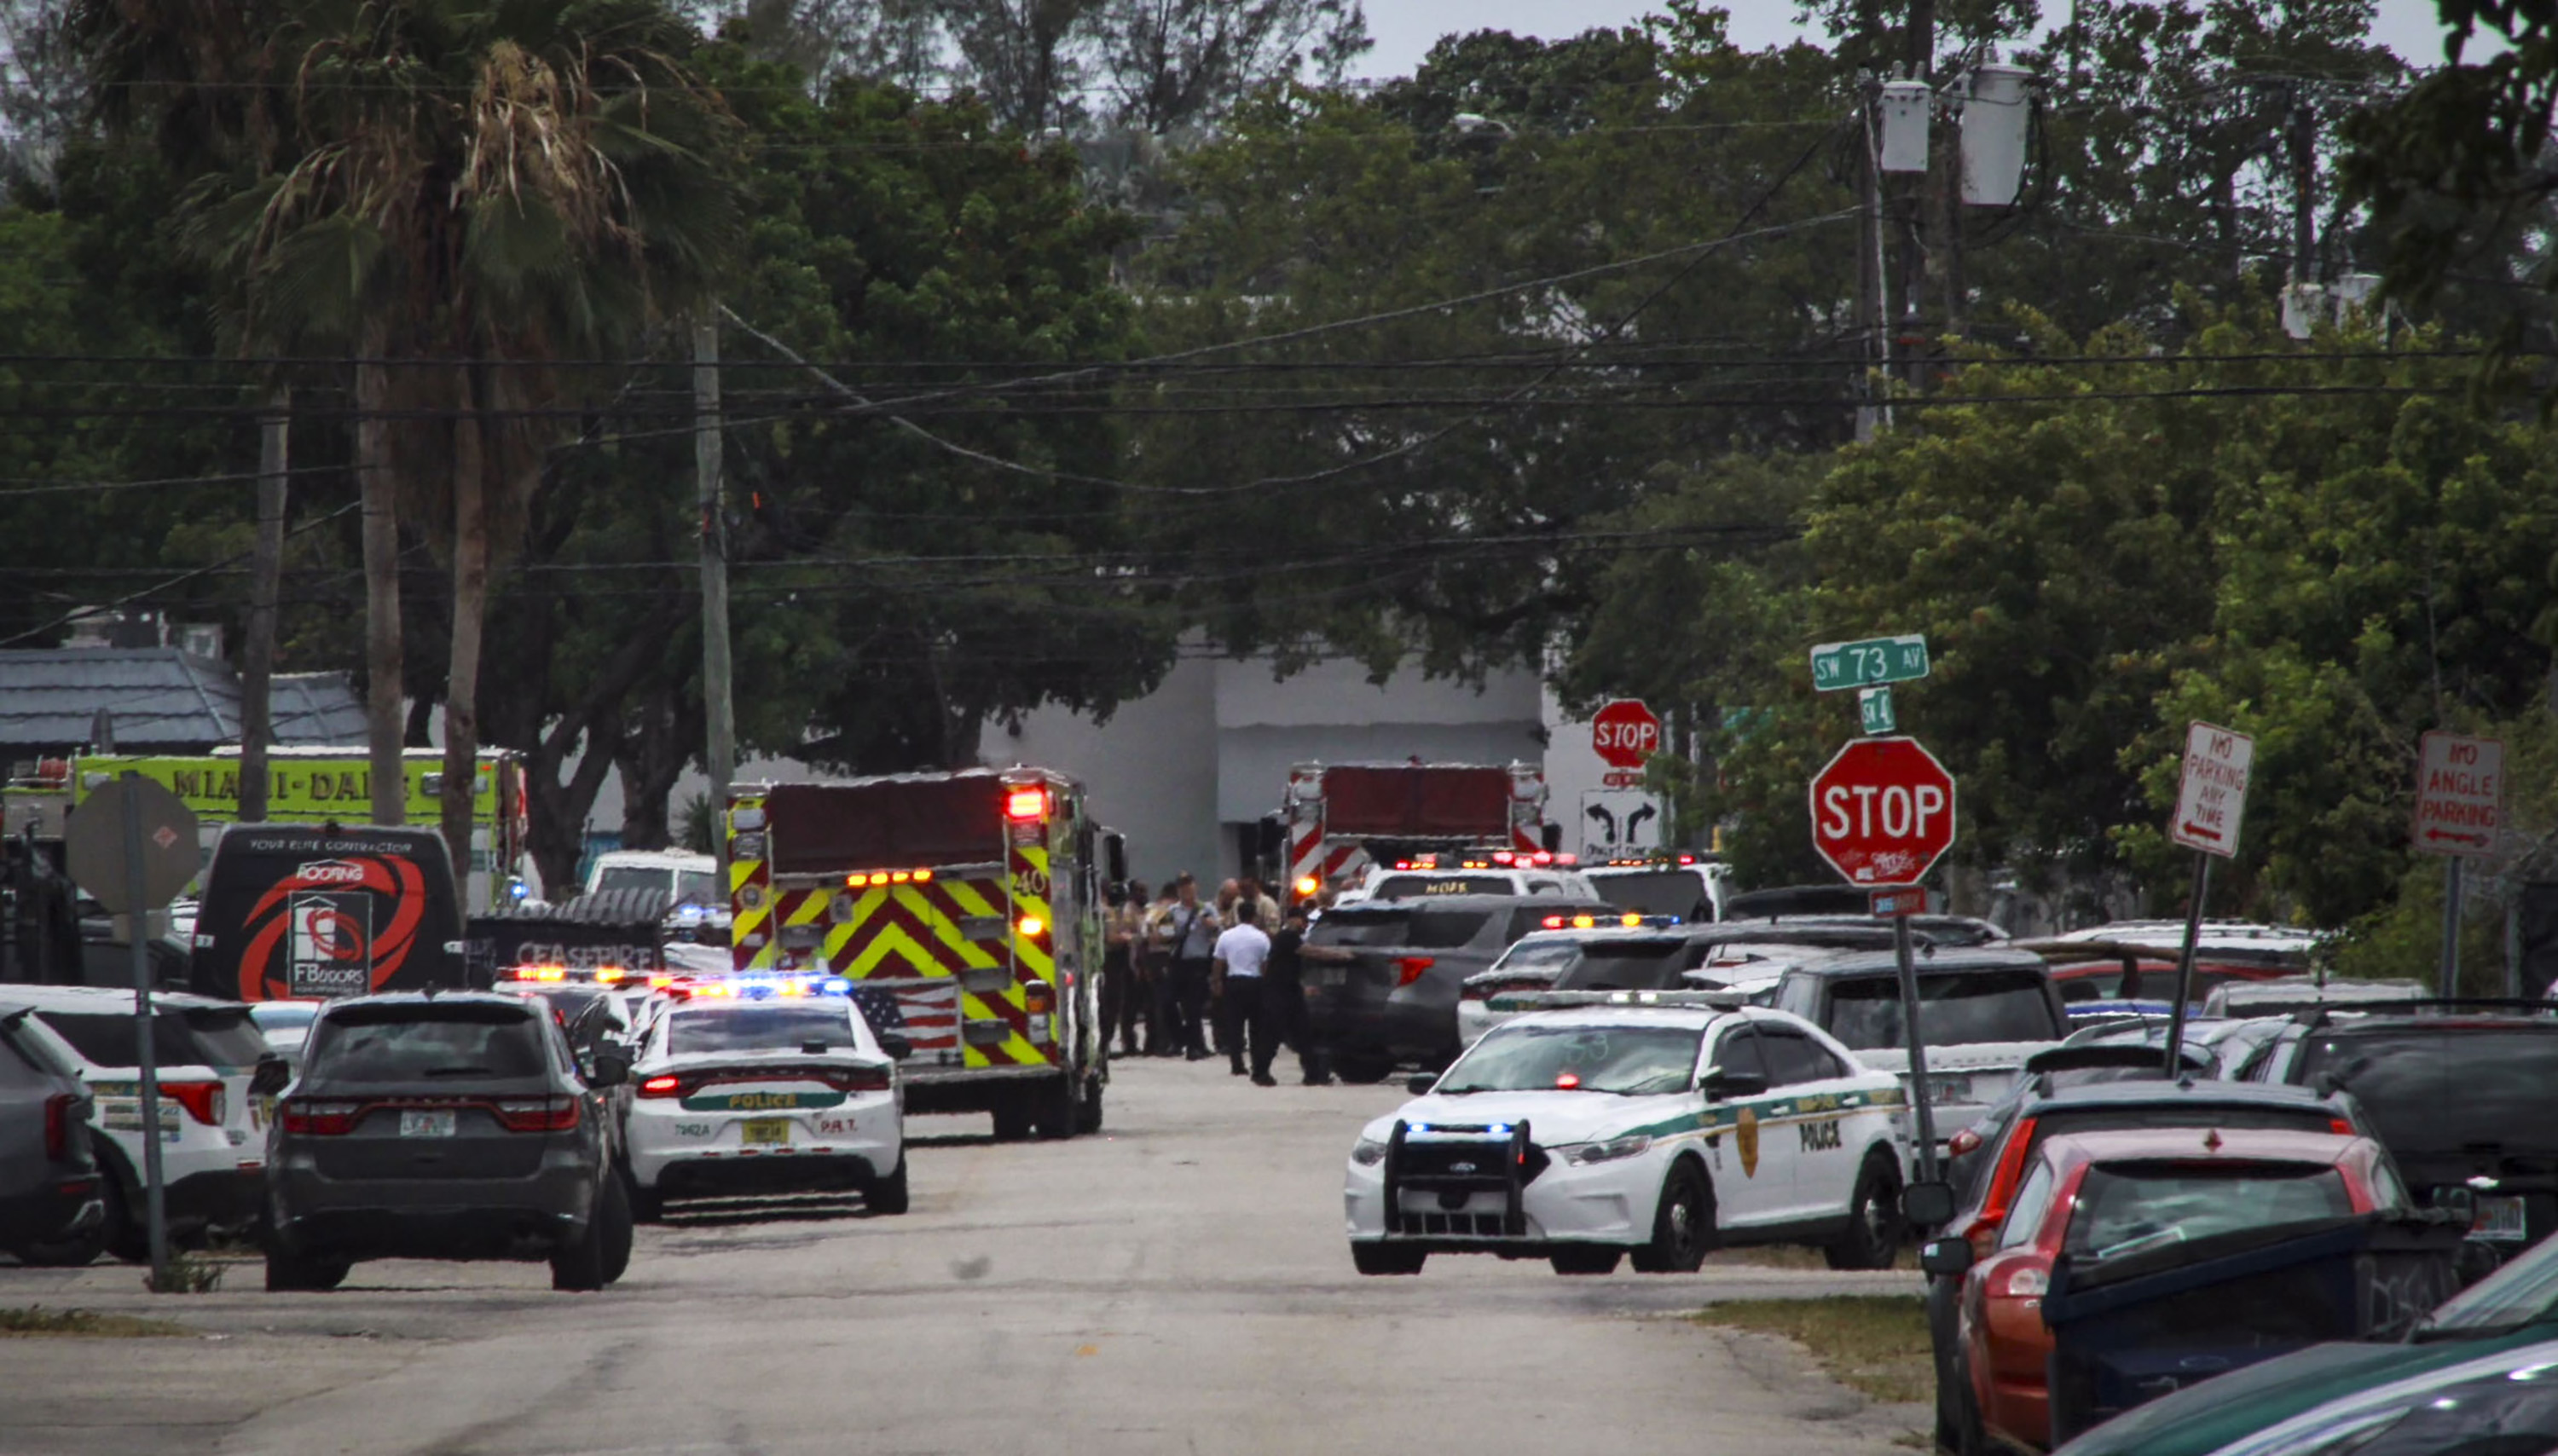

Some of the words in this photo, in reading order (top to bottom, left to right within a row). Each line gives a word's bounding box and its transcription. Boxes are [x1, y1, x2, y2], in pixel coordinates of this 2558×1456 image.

[1816, 656, 1840, 681] SW
[1849, 647, 1887, 680] 73
[1902, 648, 1921, 669] AV
[1596, 722, 1655, 748] STOP
[2209, 732, 2233, 760] NO
[2449, 742, 2478, 766] NO
[2188, 754, 2245, 792] PARKING
[2428, 768, 2493, 797] ANGLE
[2200, 784, 2226, 806] ANY
[1822, 785, 1944, 839] STOP
[2196, 802, 2225, 828] TIME
[2422, 799, 2497, 827] PARKING
[250, 839, 284, 851] YOUR
[325, 840, 413, 852] CONTRACTOR
[1012, 868, 1046, 896] 40
[729, 1093, 797, 1109] POLICE
[1798, 1119, 1842, 1153] POLICE
